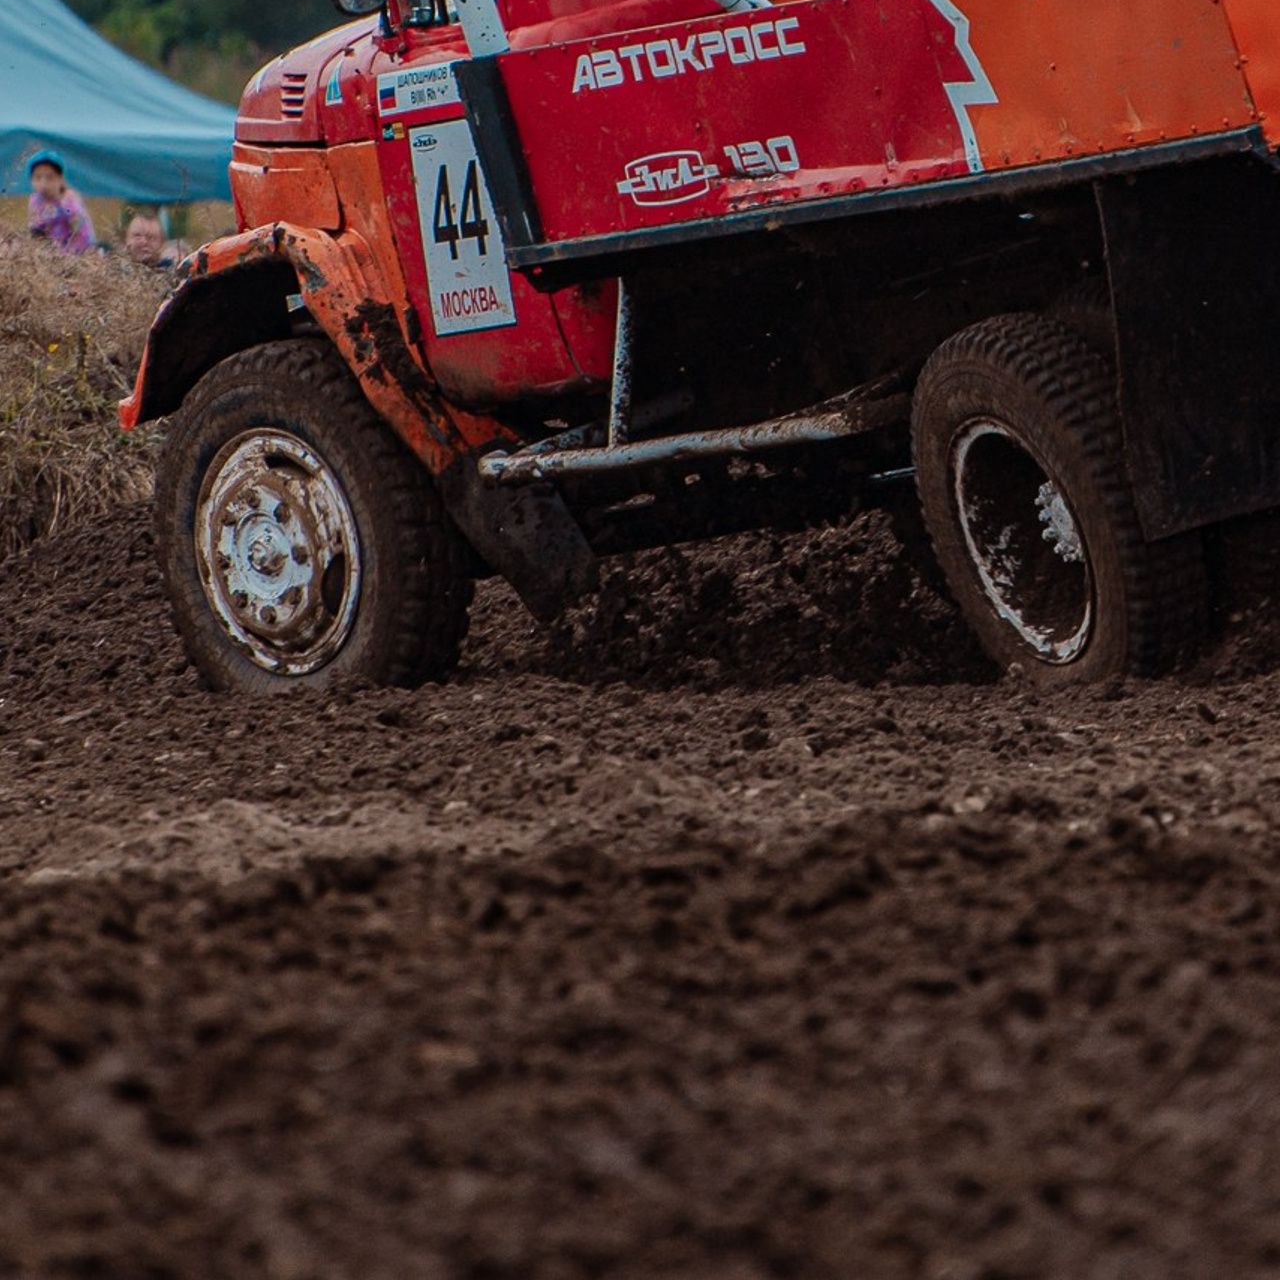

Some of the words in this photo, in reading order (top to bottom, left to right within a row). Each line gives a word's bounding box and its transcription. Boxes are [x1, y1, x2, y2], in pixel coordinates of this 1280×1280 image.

[572, 17, 806, 93] АВТОКРОСС
[723, 135, 800, 175] 130
[433, 160, 489, 260] 44
[440, 285, 499, 318] МОСКВА
